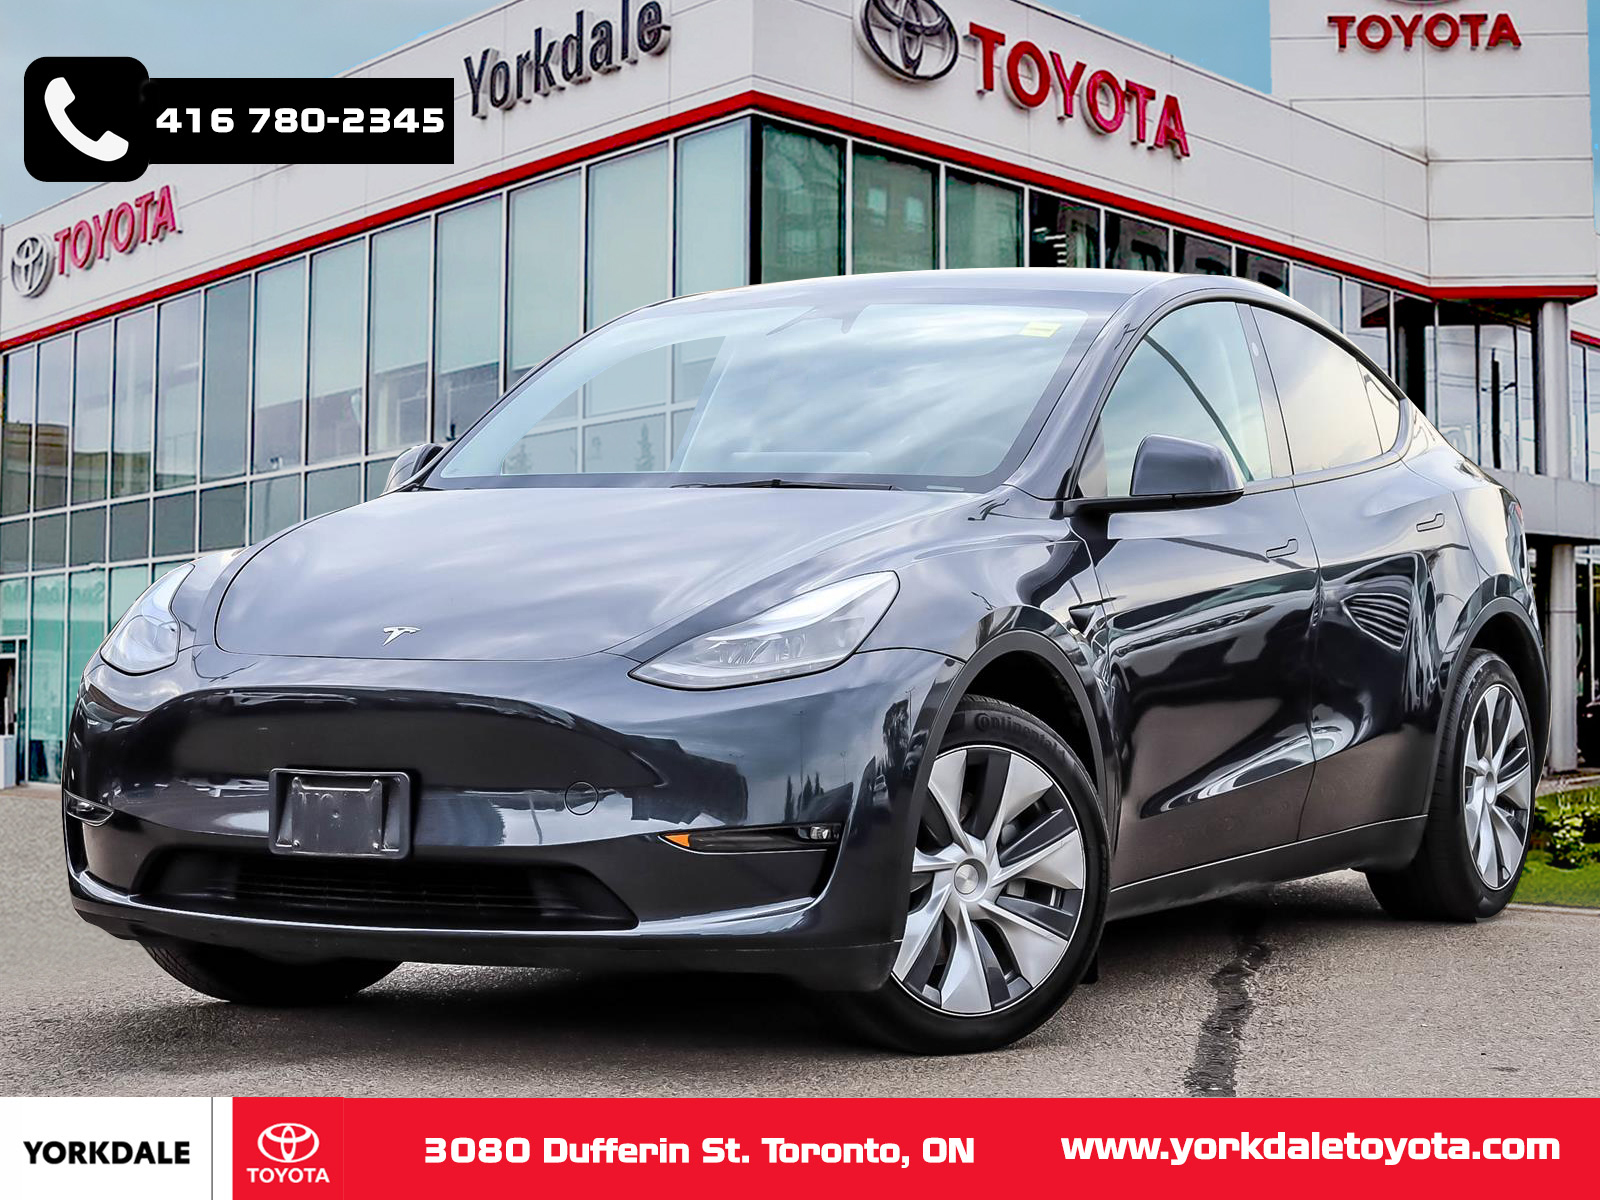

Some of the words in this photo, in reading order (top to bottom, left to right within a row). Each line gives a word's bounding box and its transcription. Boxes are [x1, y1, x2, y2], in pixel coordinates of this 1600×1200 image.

[463, 0, 672, 119] Yorkdale
[1327, 13, 1522, 50] TOYOTA
[967, 21, 1190, 158] TOYOTA
[54, 185, 180, 277] TOYOTA
